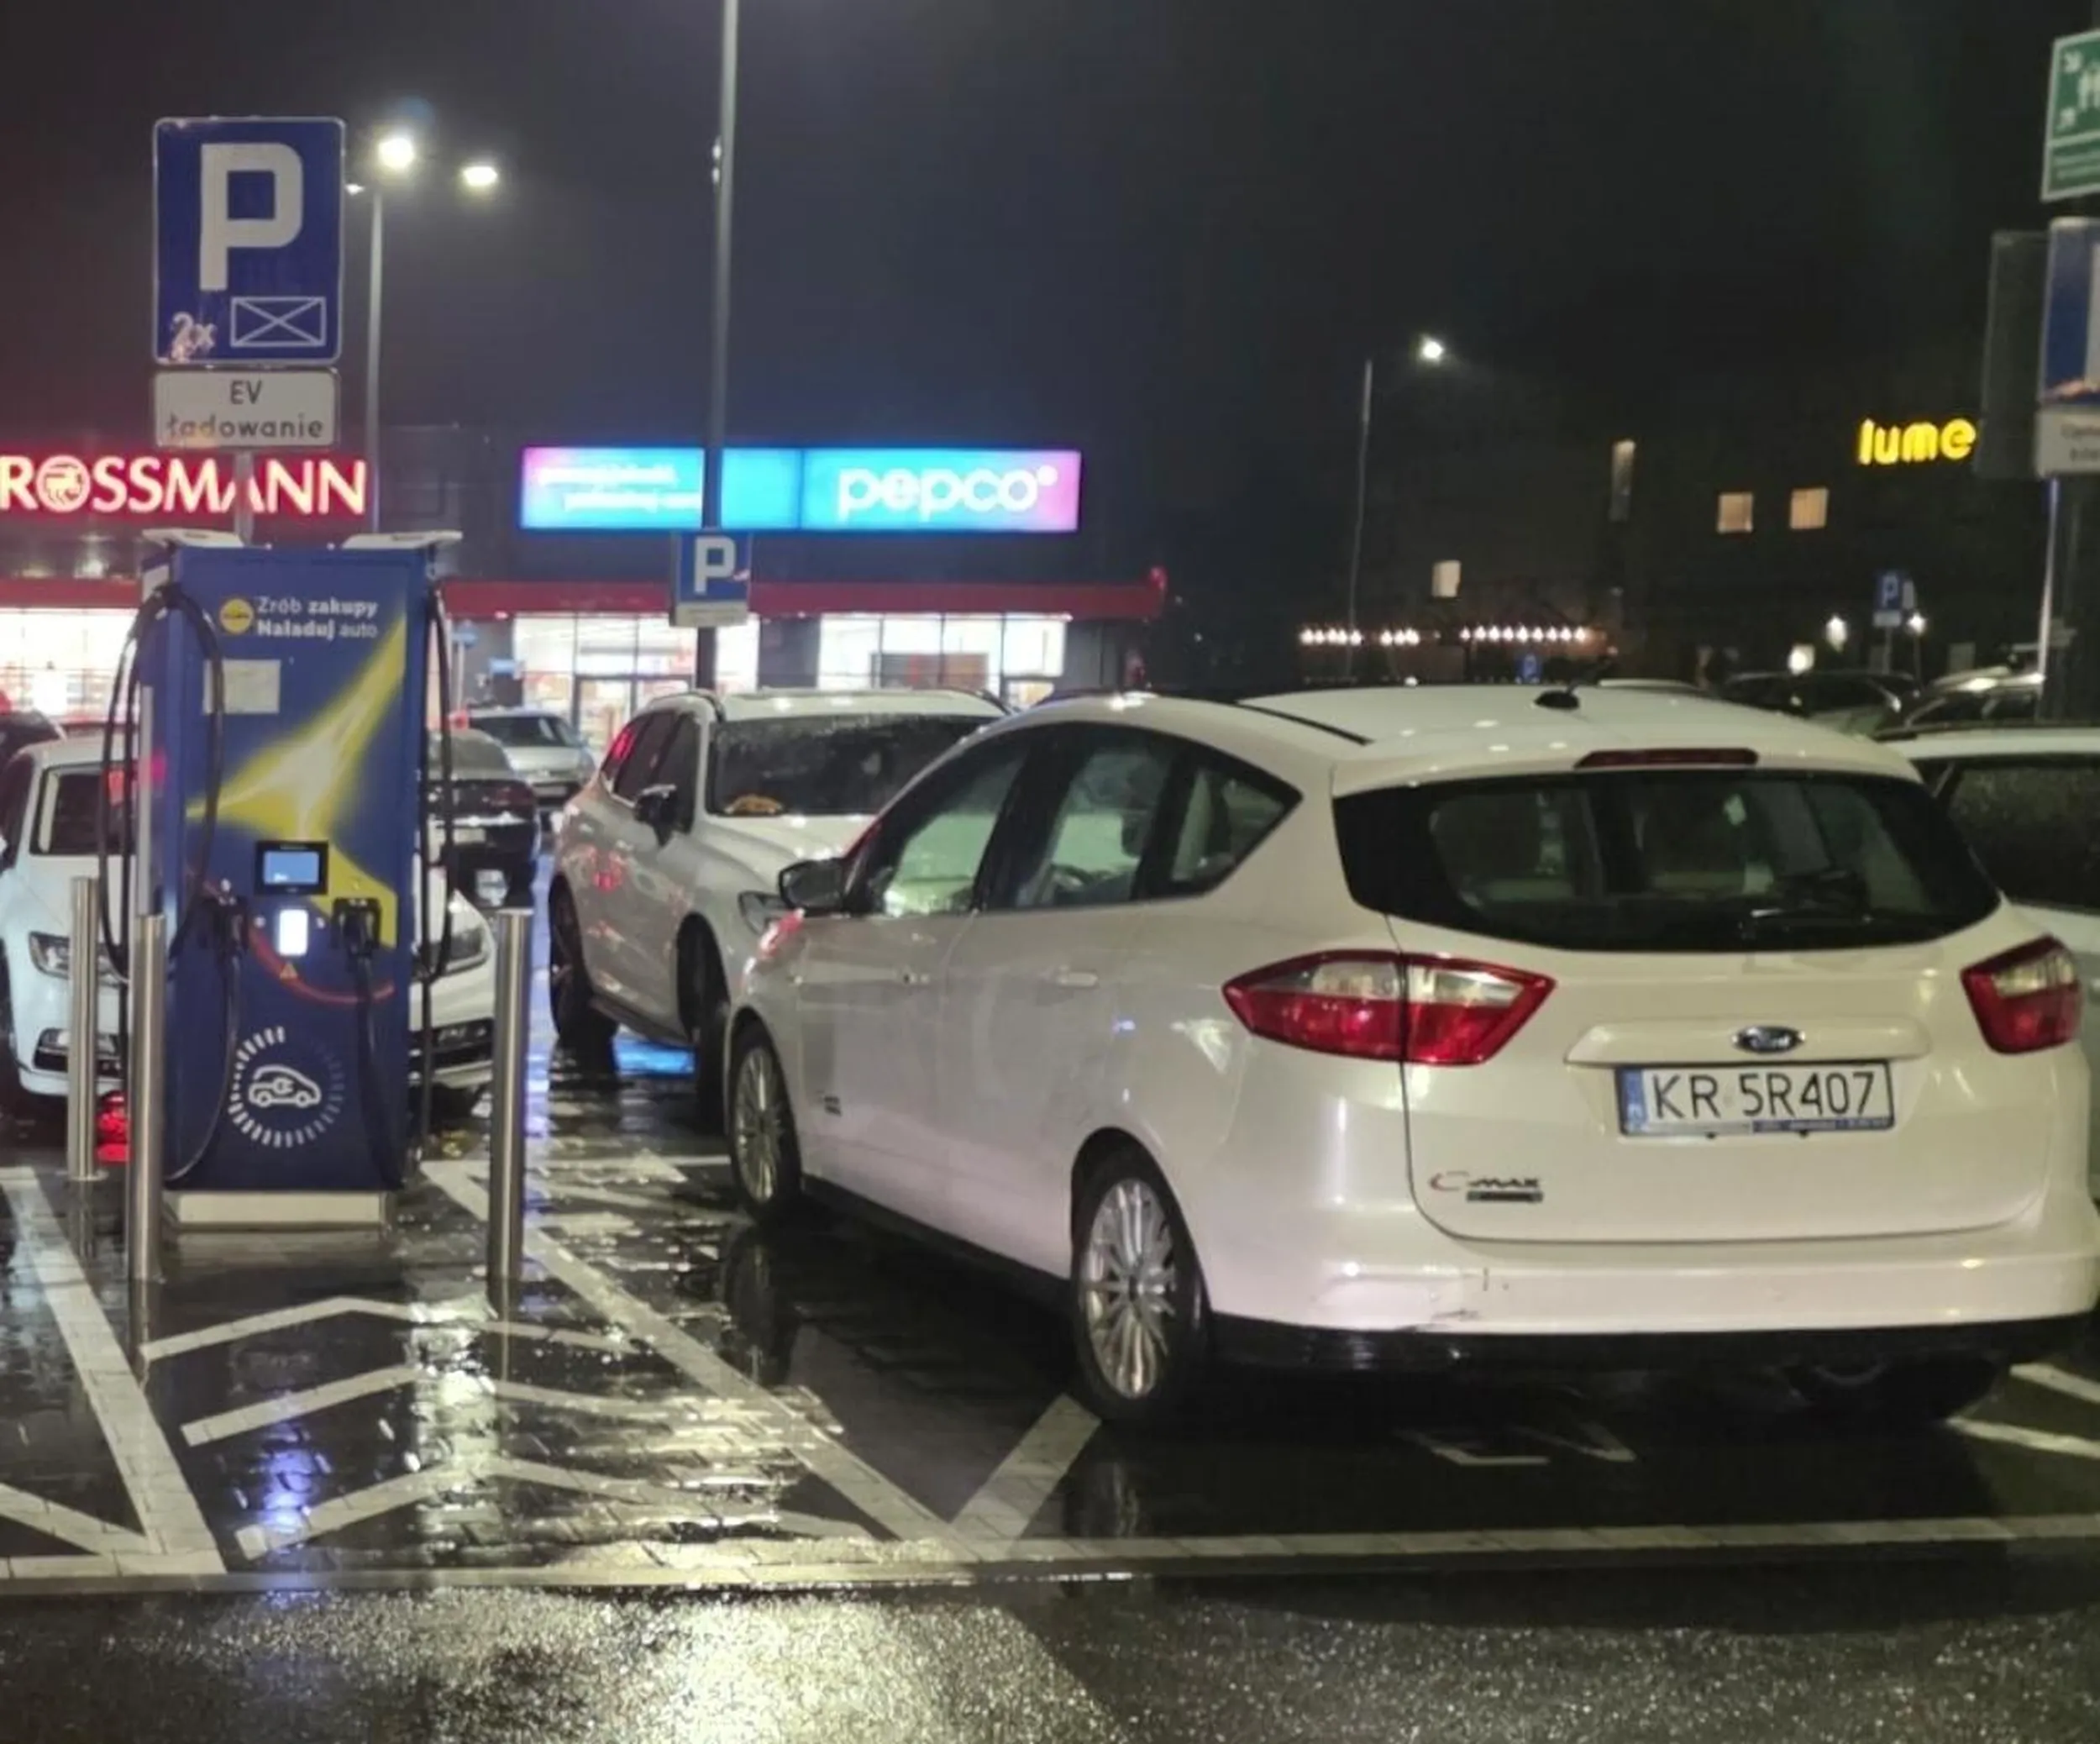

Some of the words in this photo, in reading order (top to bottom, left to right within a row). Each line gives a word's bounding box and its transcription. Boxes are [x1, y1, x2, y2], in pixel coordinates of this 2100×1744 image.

[200, 143, 304, 292] P
[229, 380, 262, 404] EV
[1859, 418, 1977, 465] lume
[837, 467, 1040, 523] pepco
[694, 536, 736, 593] P
[257, 595, 302, 615] Zrób
[308, 596, 379, 619] zakupy
[1881, 573, 1899, 607] P
[339, 622, 379, 638] auto
[1652, 1074, 1720, 1119] KR
[1739, 1070, 1875, 1117] 5R407
